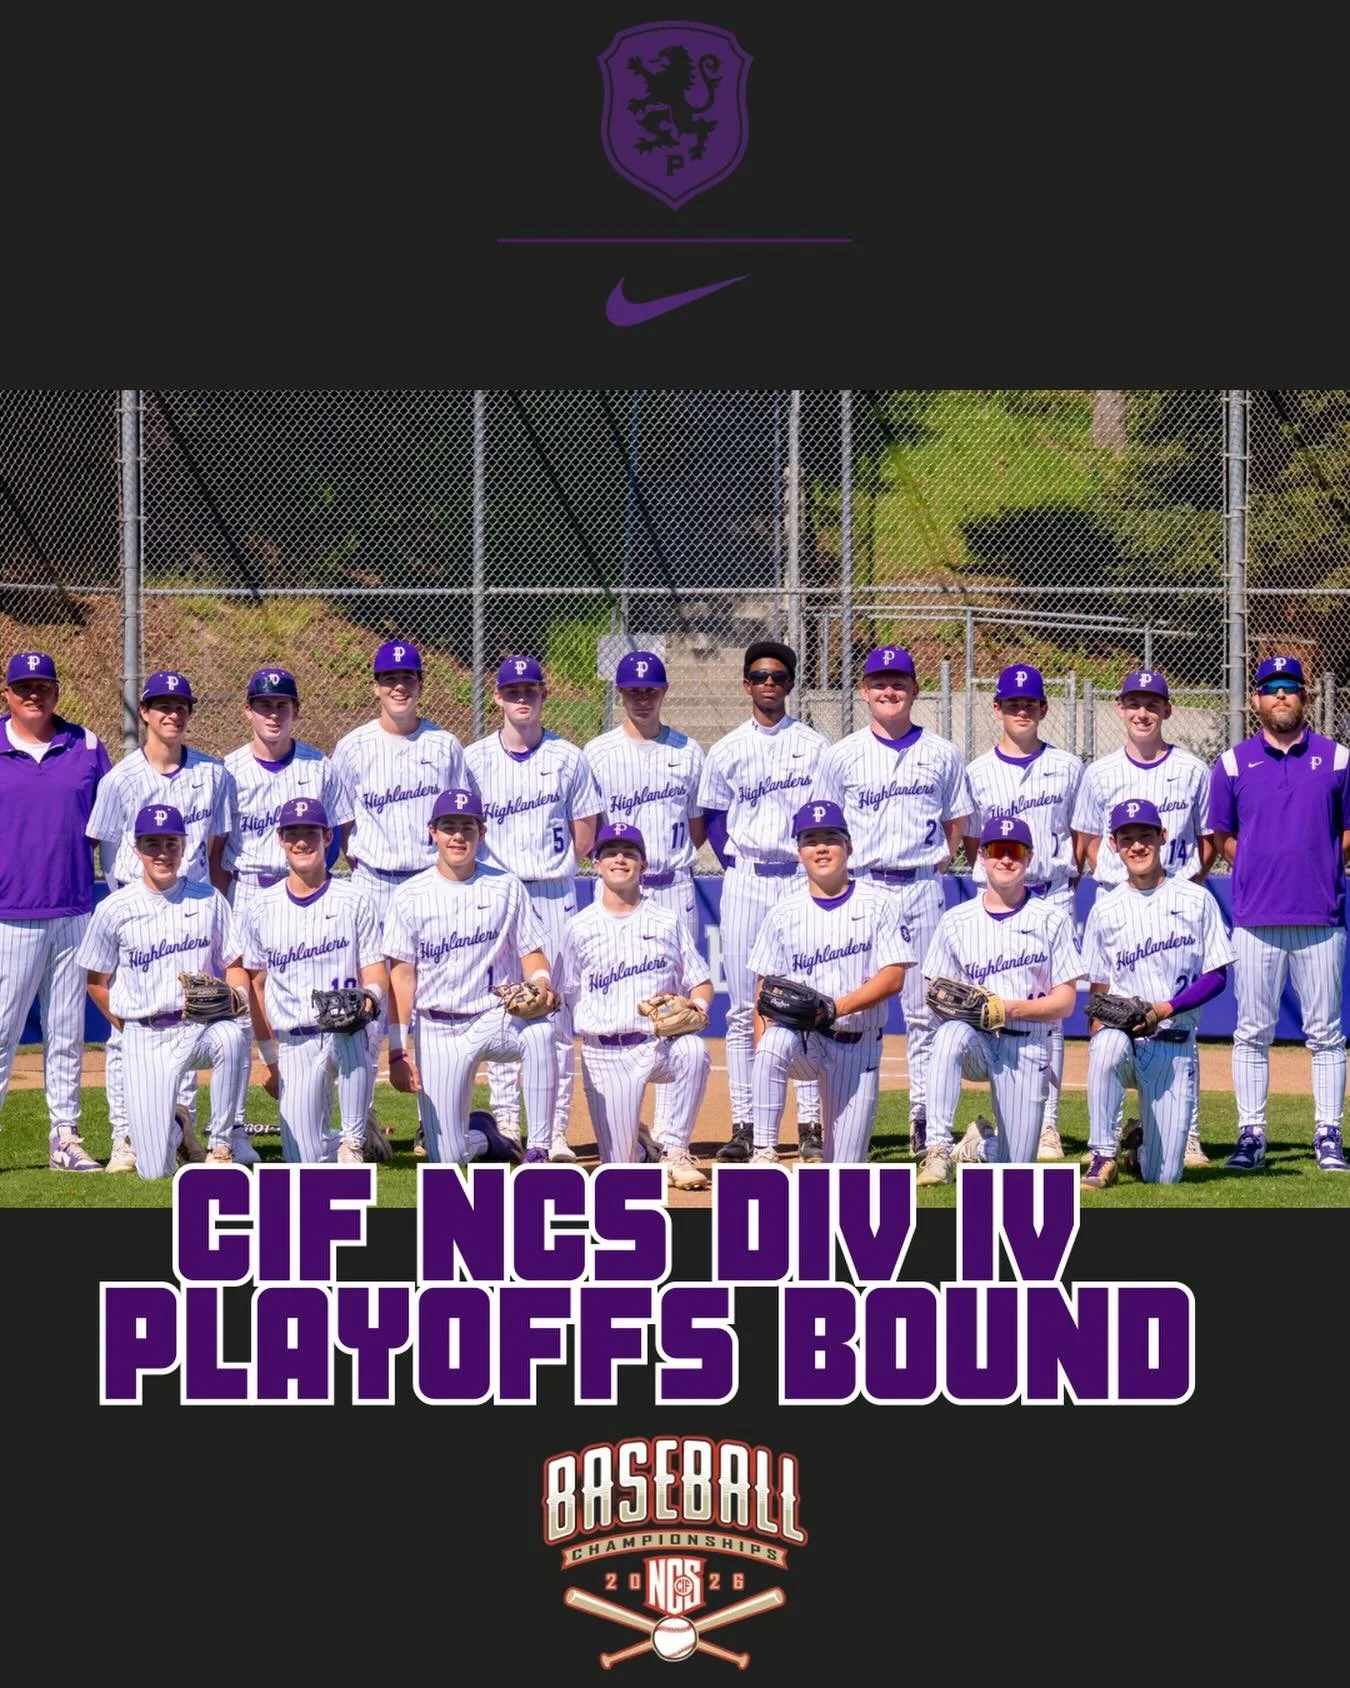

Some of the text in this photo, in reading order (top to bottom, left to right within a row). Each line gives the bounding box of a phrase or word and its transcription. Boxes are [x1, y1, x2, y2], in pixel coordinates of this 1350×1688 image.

[363, 781, 441, 815] Highlanders
[609, 782, 688, 816] Highlanders
[739, 772, 812, 807] Highlanders
[858, 779, 935, 811] Highlanders
[482, 791, 560, 825] Highlanders
[553, 827, 564, 853] 5
[924, 819, 937, 846] 2
[1168, 838, 1188, 866] 14
[129, 934, 211, 973] Highlanders
[267, 936, 350, 974] Highlanders
[419, 927, 500, 965] Highlanders
[792, 938, 873, 975] Highlanders
[1116, 931, 1196, 972] Highlanders
[588, 955, 668, 995] Highlanders
[964, 950, 1049, 986] Highlanders
